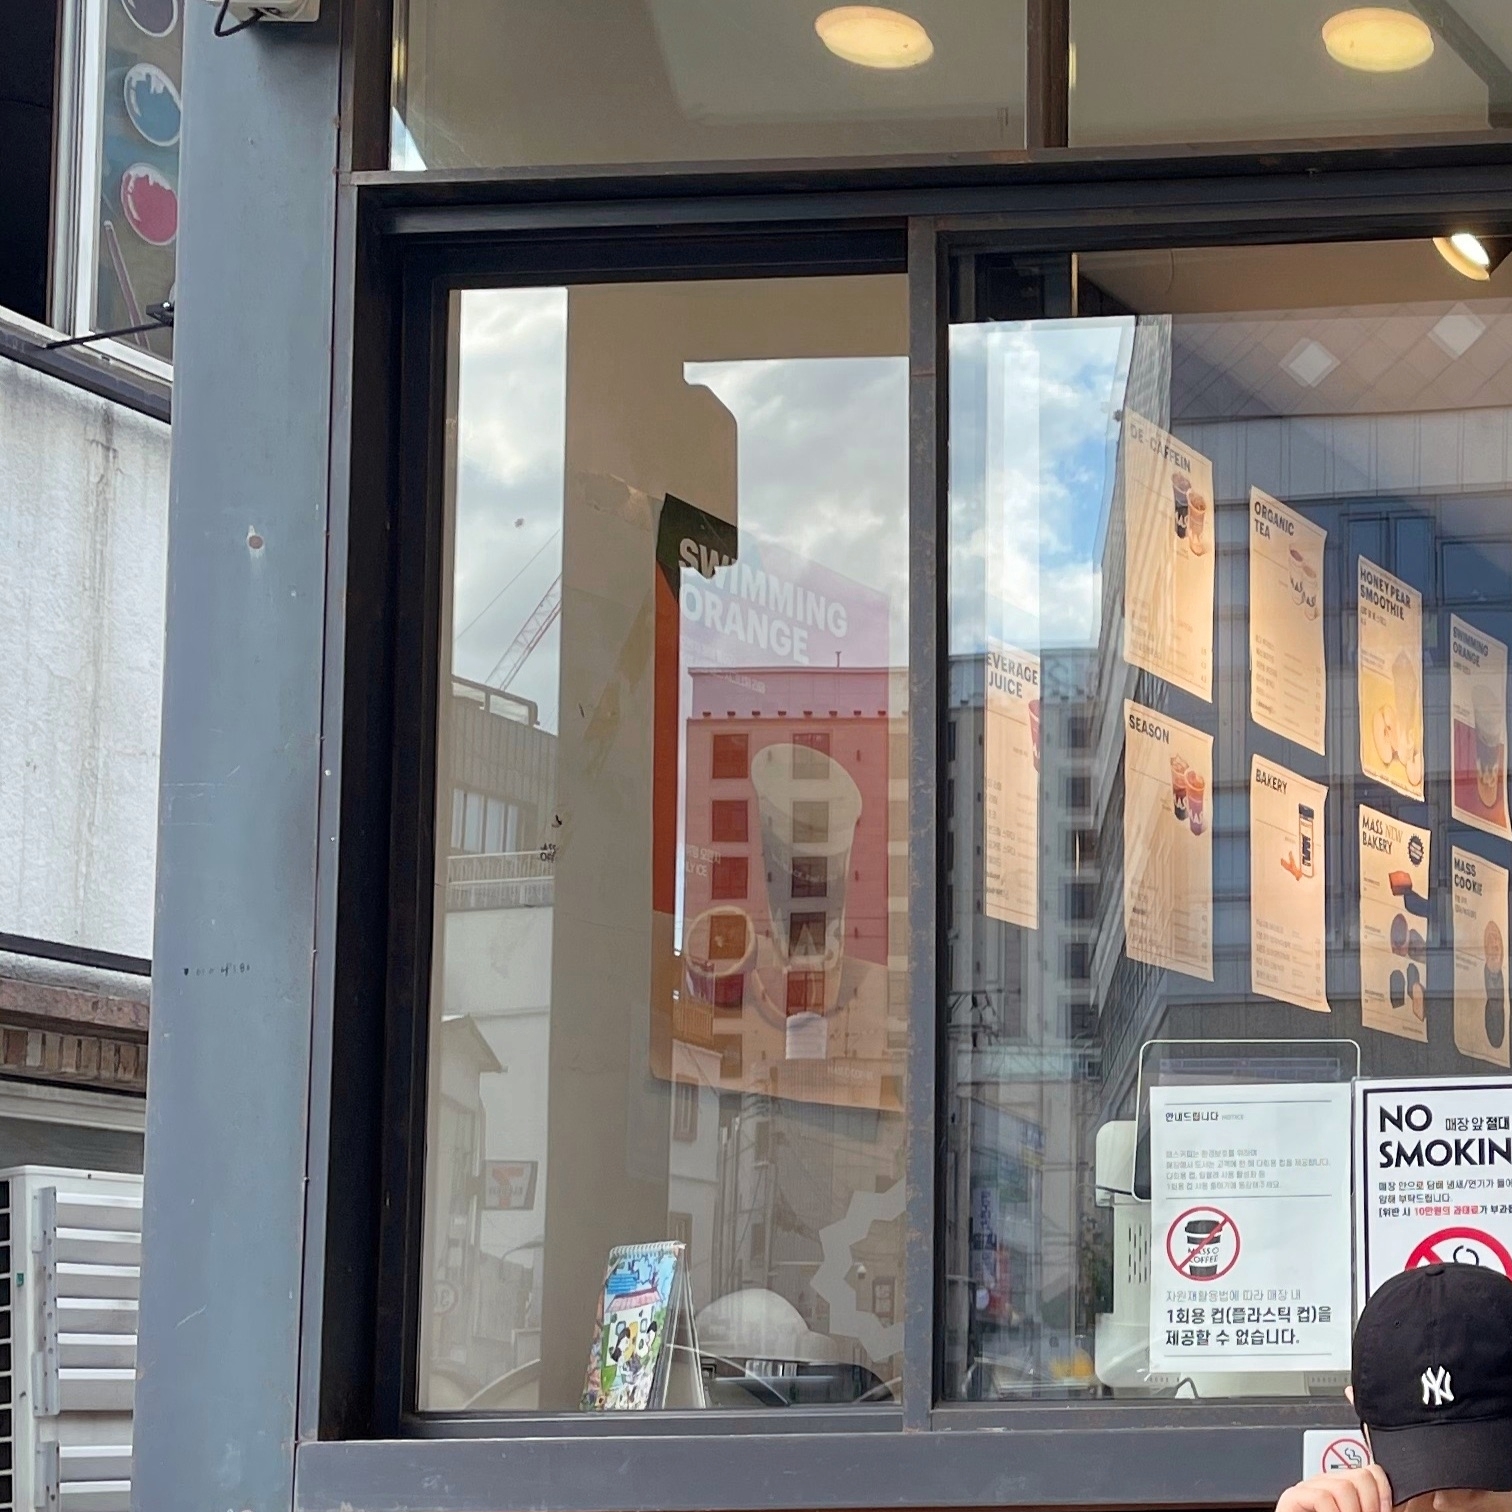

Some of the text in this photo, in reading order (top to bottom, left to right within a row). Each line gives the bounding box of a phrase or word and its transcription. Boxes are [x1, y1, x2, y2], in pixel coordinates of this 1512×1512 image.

[1254, 501, 1295, 536] ORGANIC
[1254, 519, 1271, 540] TEA
[679, 538, 849, 638] SWIMMING
[1360, 567, 1411, 609] HONEY PEAR
[1360, 584, 1405, 621] SMOOTHIE
[682, 582, 810, 664] ORANGE
[1453, 627, 1489, 656] SWIMMING
[1453, 641, 1480, 668] ORANGE
[987, 652, 1039, 686] EVERAGE
[988, 670, 1023, 699] JUICE
[1128, 714, 1170, 745] SEASON
[1256, 768, 1287, 795] BAKERY
[1362, 815, 1383, 836] MASS
[1362, 831, 1393, 855] BAKERY
[1454, 857, 1477, 877] MASS
[1454, 873, 1483, 897] COOKIE
[1165, 1111, 1219, 1122] 안내드립니다
[1379, 1104, 1433, 1132] NO
[1445, 1117, 1469, 1132] 매장
[1472, 1117, 1484, 1131] 앞
[1486, 1116, 1510, 1130] 절대
[1379, 1181, 1396, 1191] 매장
[1402, 1207, 1411, 1217] 시
[1243, 1289, 1264, 1301] 따라
[1267, 1289, 1288, 1301] 매장
[1291, 1289, 1301, 1300] 내
[1167, 1305, 1332, 1324] 1회용 컵(플라스틱 컵)을
[1165, 1328, 1300, 1346] 제공할 수 없습니다.
[1421, 1366, 1455, 1405] NY
